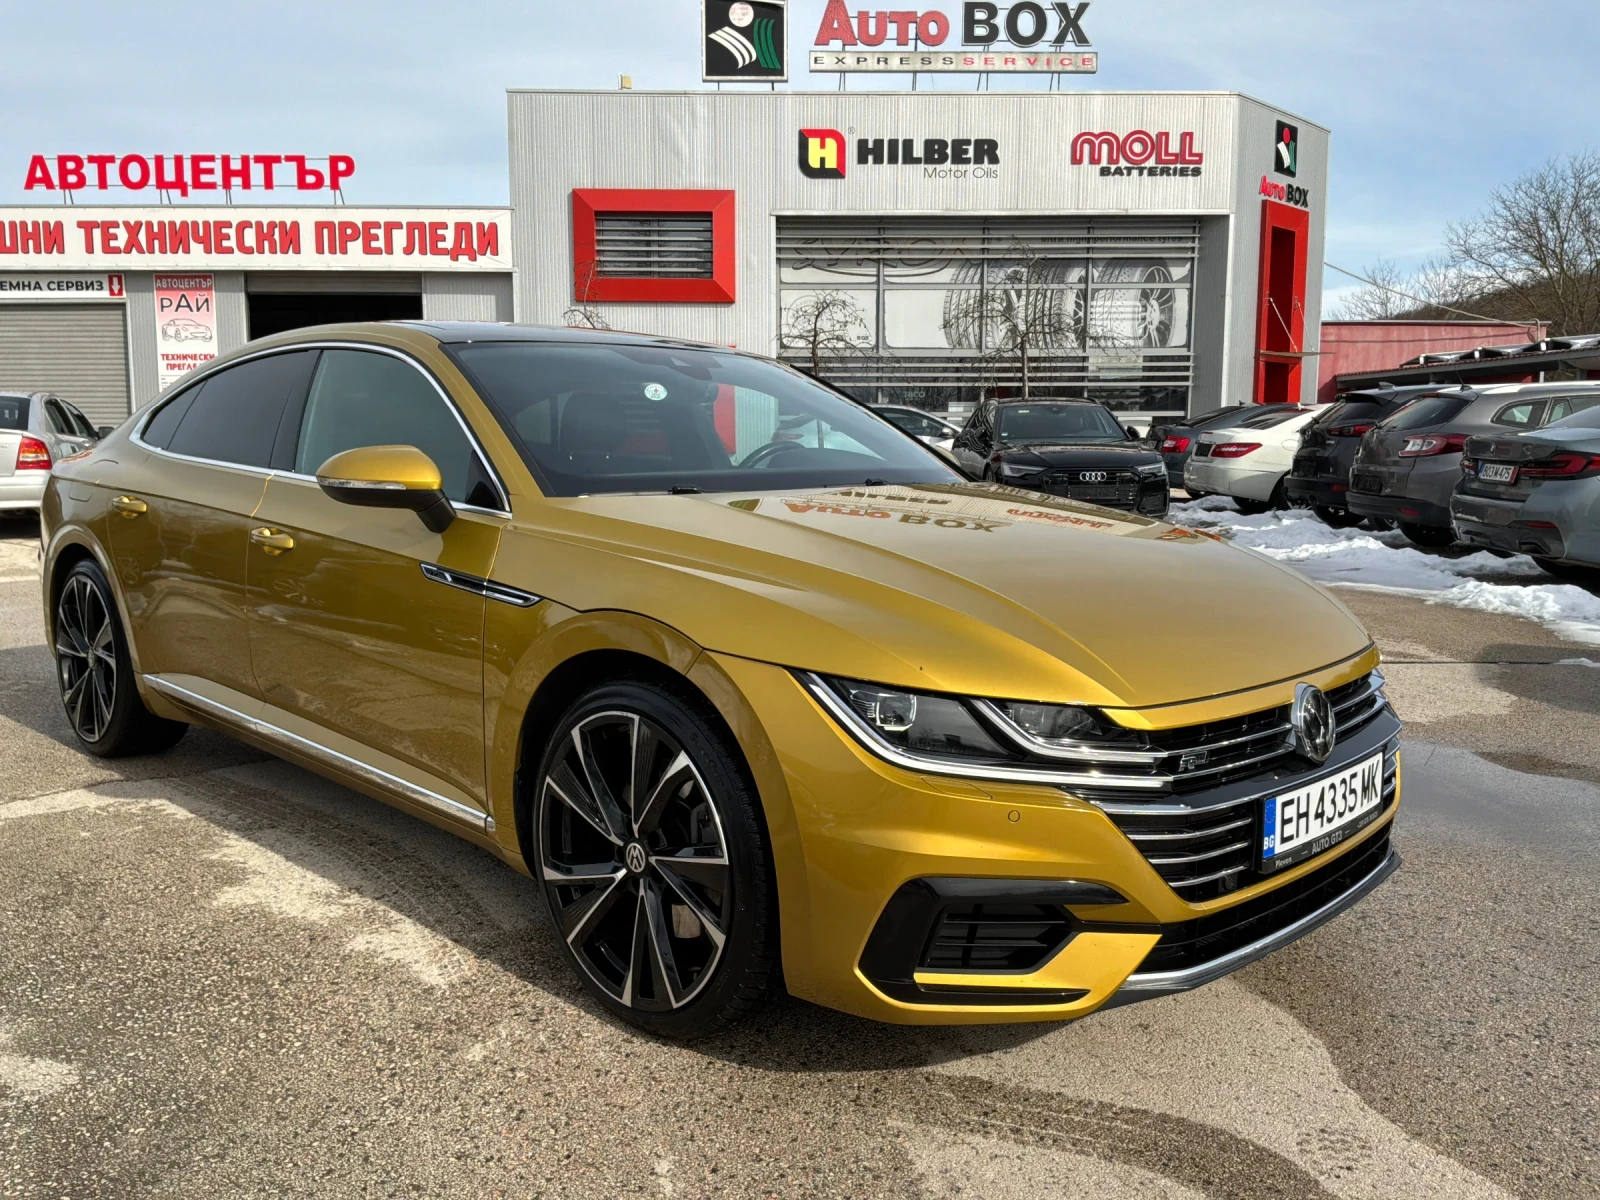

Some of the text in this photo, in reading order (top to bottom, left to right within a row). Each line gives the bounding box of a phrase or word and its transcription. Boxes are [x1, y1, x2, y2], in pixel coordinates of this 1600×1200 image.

[961, 1, 1092, 48] BOX
[857, 139, 1000, 165] HILBER
[1071, 130, 1203, 165] MOLL
[24, 154, 355, 197] АВТОЦЕНТЪР
[924, 167, 999, 179] Motor Oils
[1099, 166, 1202, 177] BATTERIES
[1286, 183, 1309, 208] BOX
[77, 221, 301, 254] ТЕХНИЧЕСКИ
[315, 221, 499, 261] ПРЕГЛЕДИ
[47, 281, 104, 291] СЕРВИЗ
[156, 278, 212, 289] АВТОЦЕНТЪР
[160, 293, 210, 312] РАЙ
[1280, 760, 1380, 845] EH 4335 MK
[1263, 835, 1275, 850] BG
[1312, 830, 1343, 854] AUTO GT3
